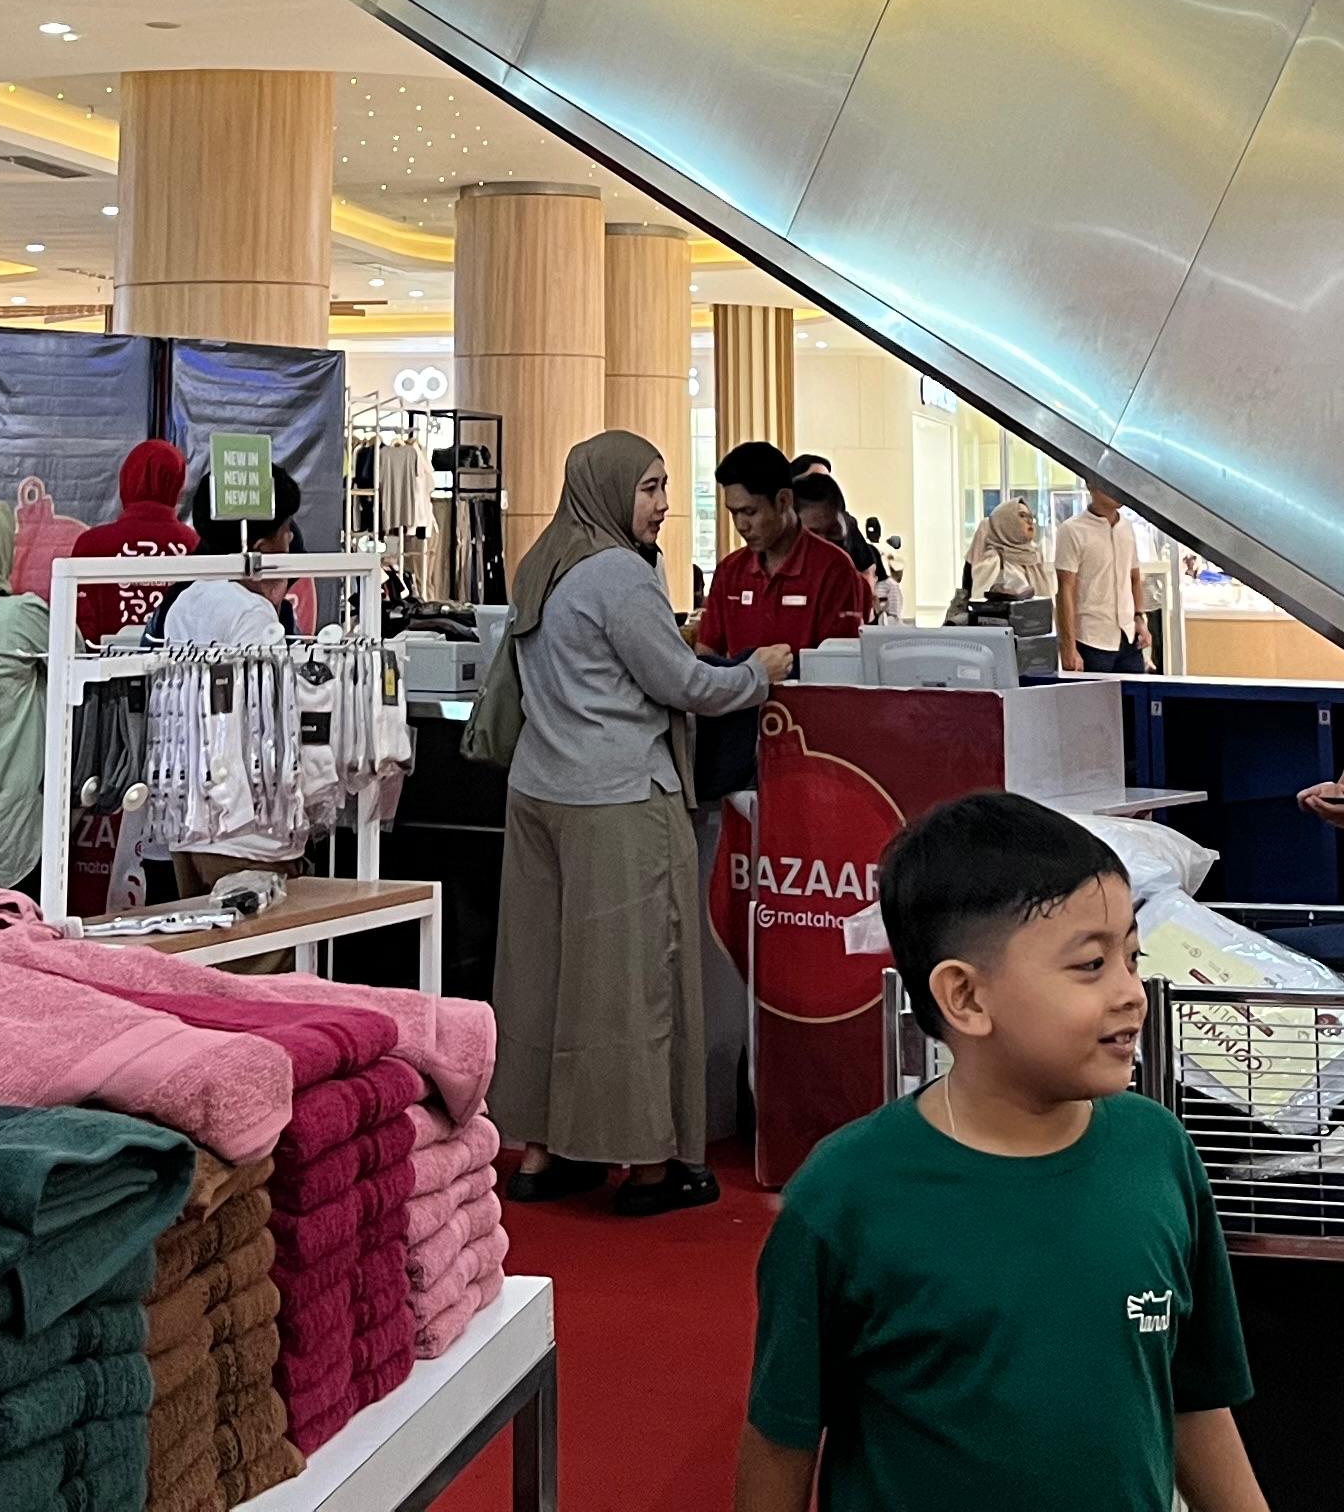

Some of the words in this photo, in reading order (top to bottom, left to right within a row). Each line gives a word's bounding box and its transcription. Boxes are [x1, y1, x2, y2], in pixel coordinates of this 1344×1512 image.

[223, 450, 247, 467] NEW
[224, 470, 248, 486] NEW
[224, 490, 248, 506] NEW
